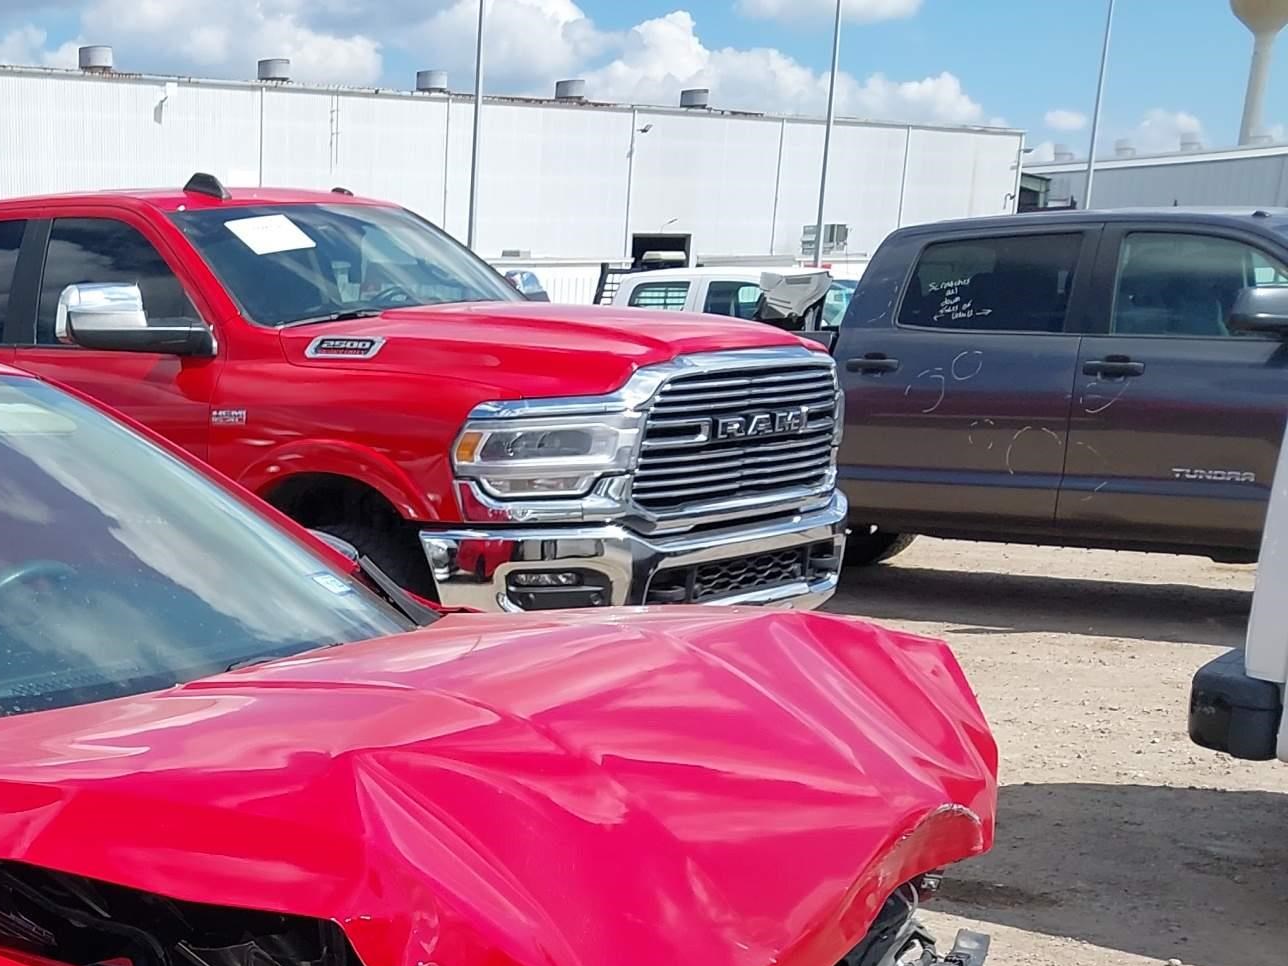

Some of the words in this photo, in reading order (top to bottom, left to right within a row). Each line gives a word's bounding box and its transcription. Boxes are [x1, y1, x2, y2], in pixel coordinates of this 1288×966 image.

[321, 340, 372, 349] 2500
[717, 406, 809, 439] RAM
[1172, 468, 1255, 482] TUNDRA
